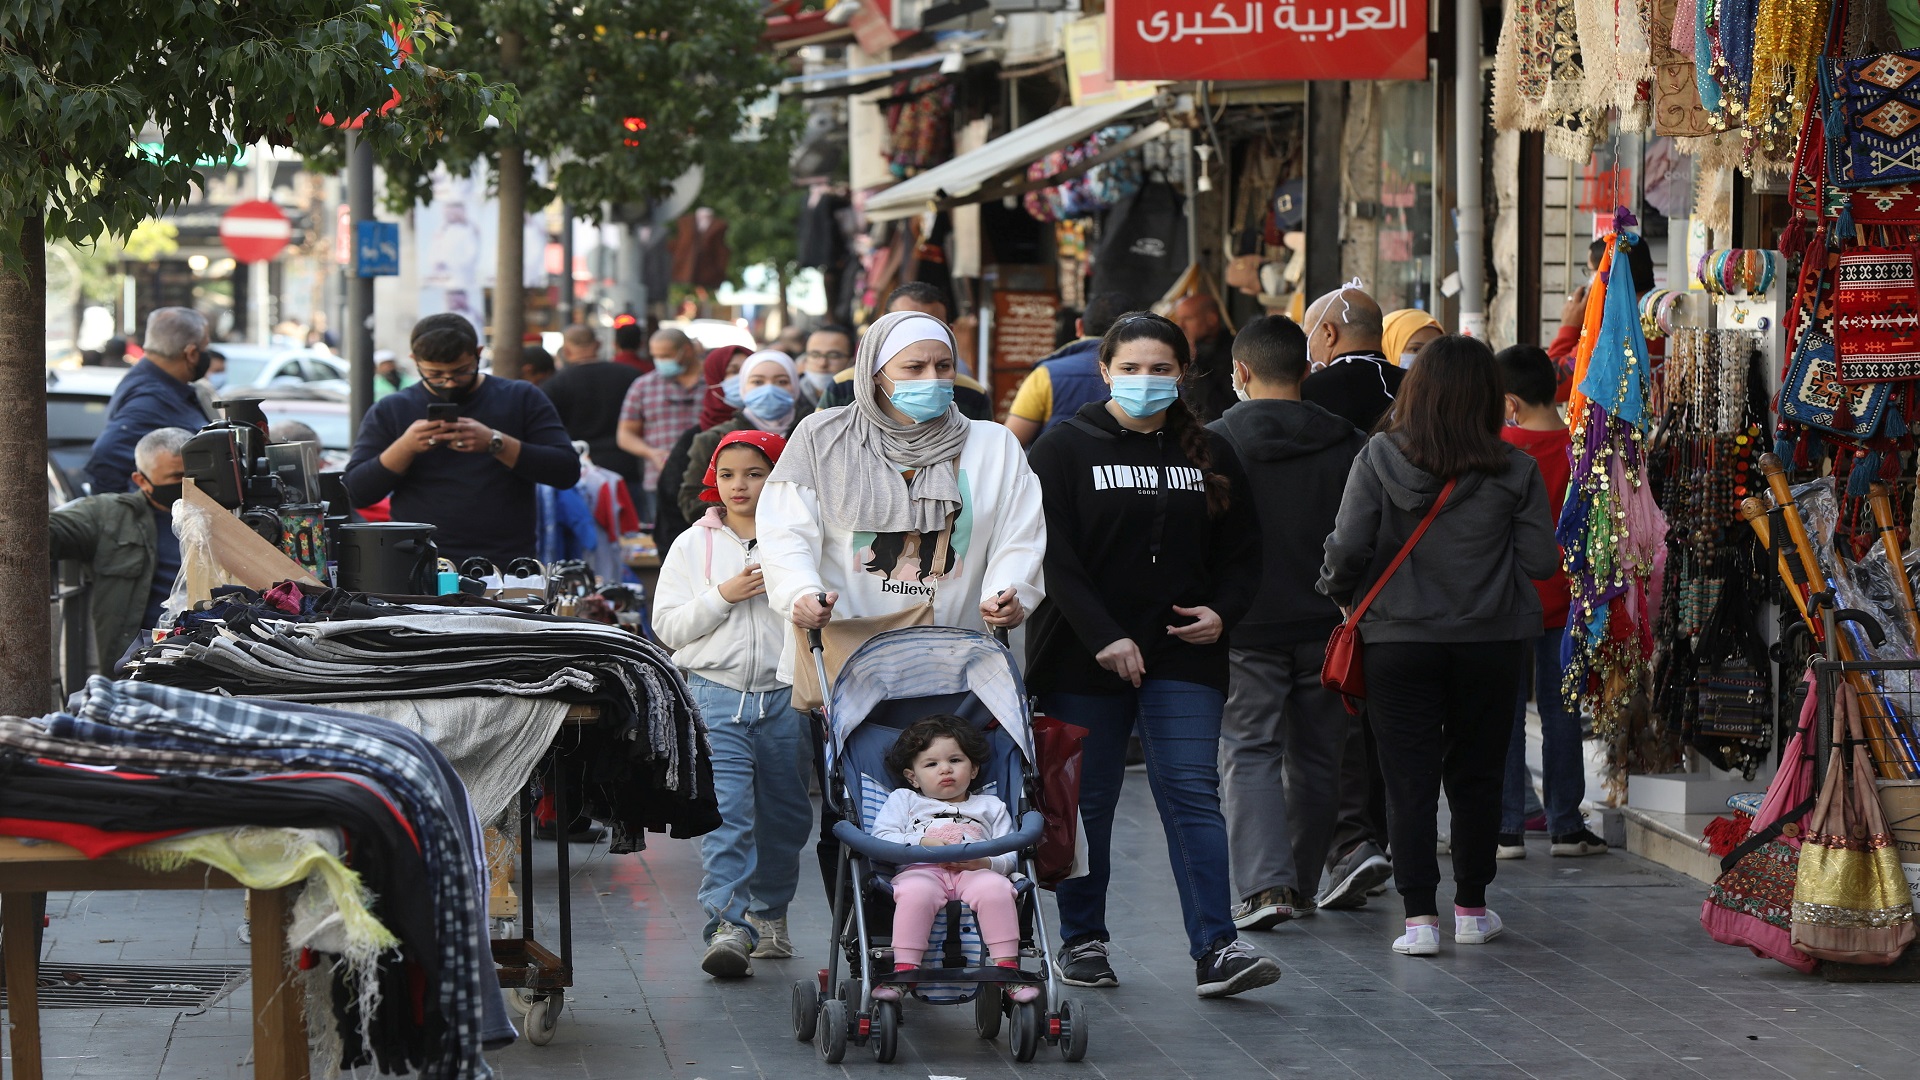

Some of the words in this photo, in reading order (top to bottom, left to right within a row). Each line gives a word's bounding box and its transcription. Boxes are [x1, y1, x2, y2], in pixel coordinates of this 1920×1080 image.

[1136, 2, 1263, 45] الكبرى
[1273, 0, 1407, 42] العربية
[881, 579, 934, 596] believe
